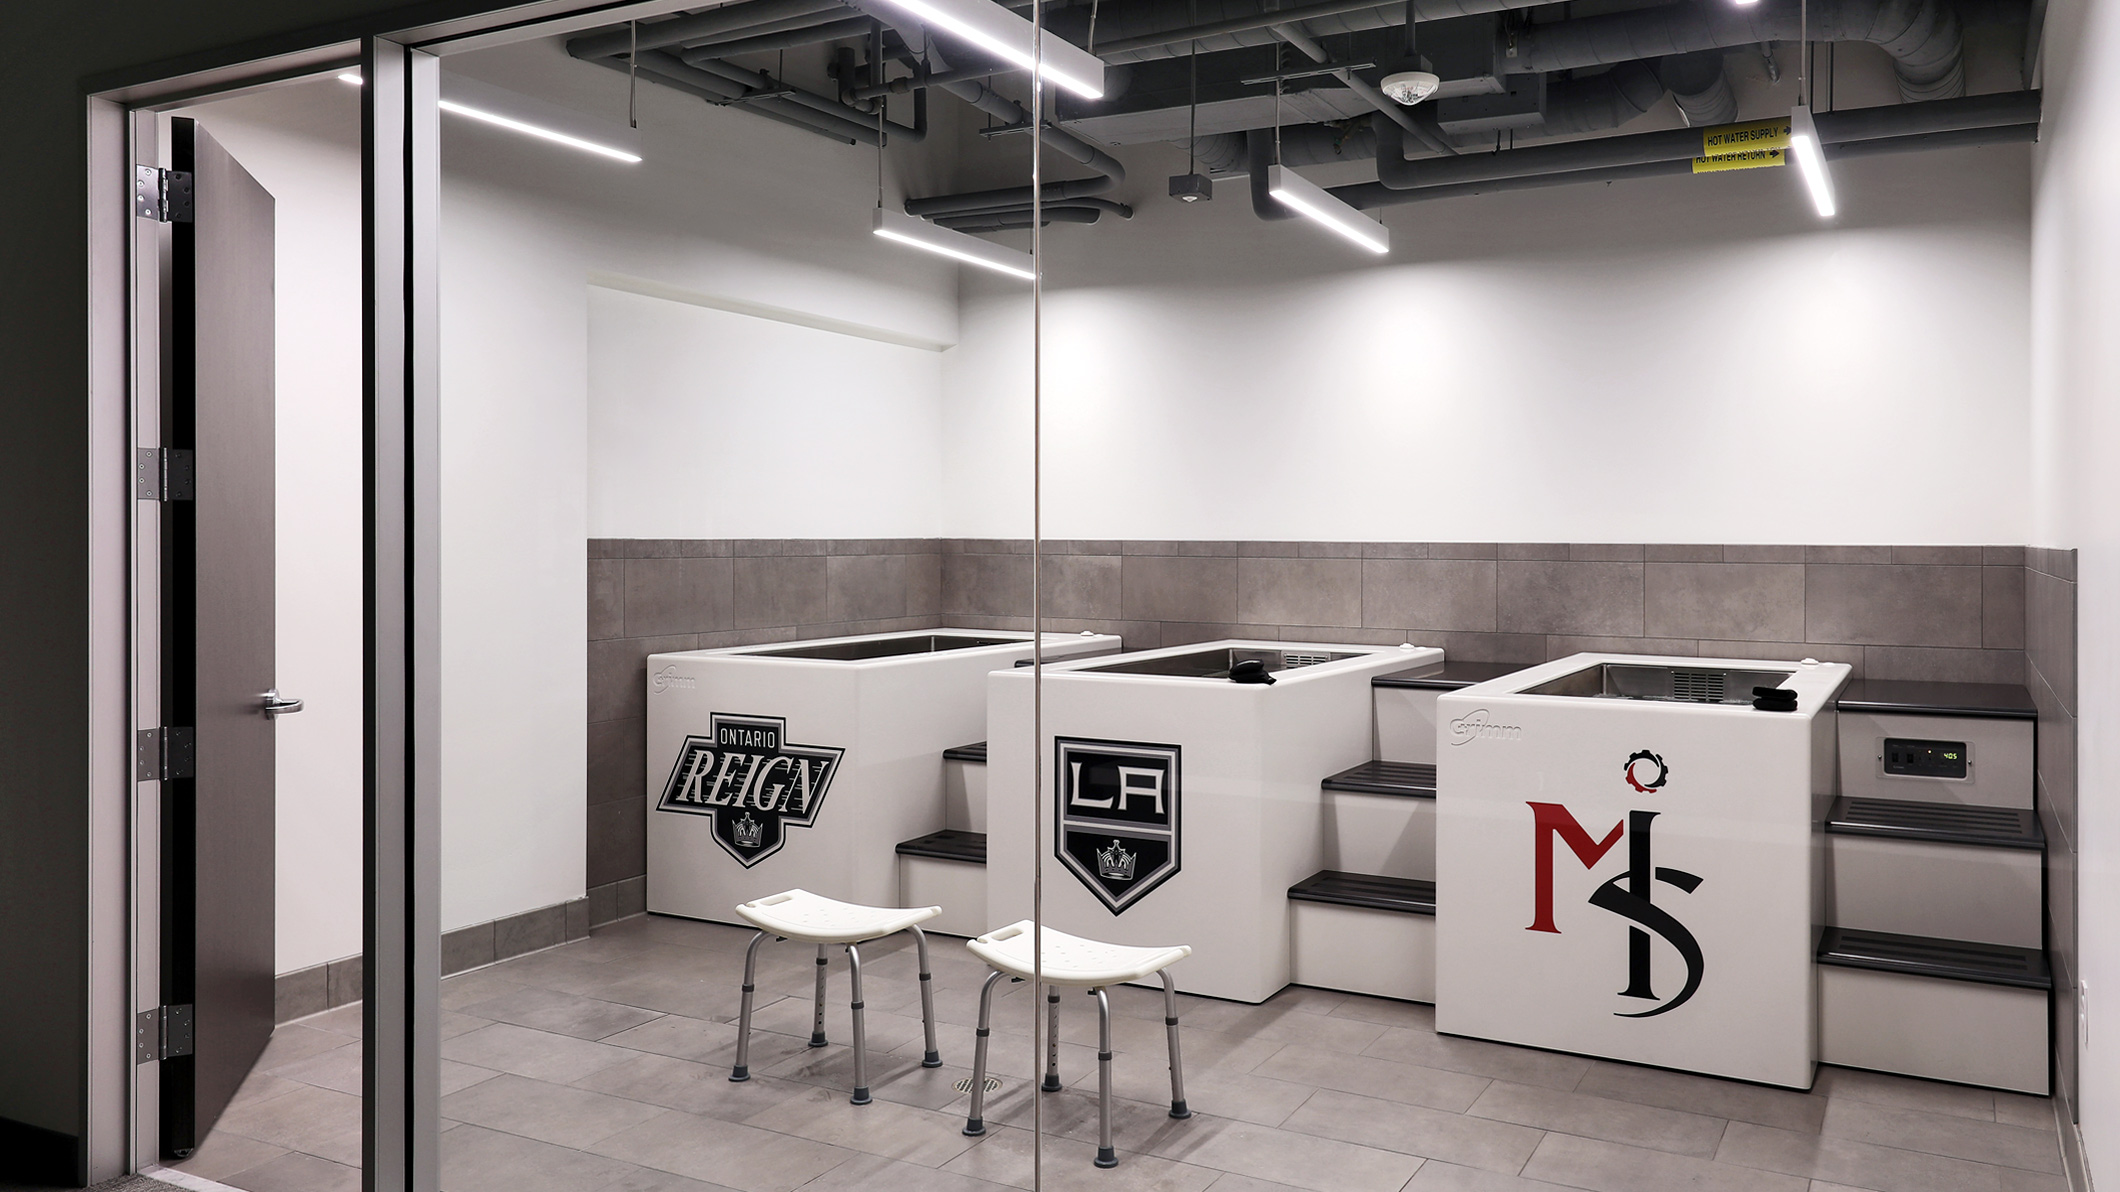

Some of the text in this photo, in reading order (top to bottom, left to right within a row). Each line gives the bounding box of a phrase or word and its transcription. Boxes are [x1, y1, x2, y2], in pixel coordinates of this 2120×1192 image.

[1708, 127, 1779, 146] HOT WATER SUPPLY
[1696, 154, 1710, 164] HOT
[1712, 152, 1737, 162] WATER
[720, 728, 775, 748] ONTARIO
[676, 749, 830, 814] REIGN
[1070, 761, 1165, 814] LA
